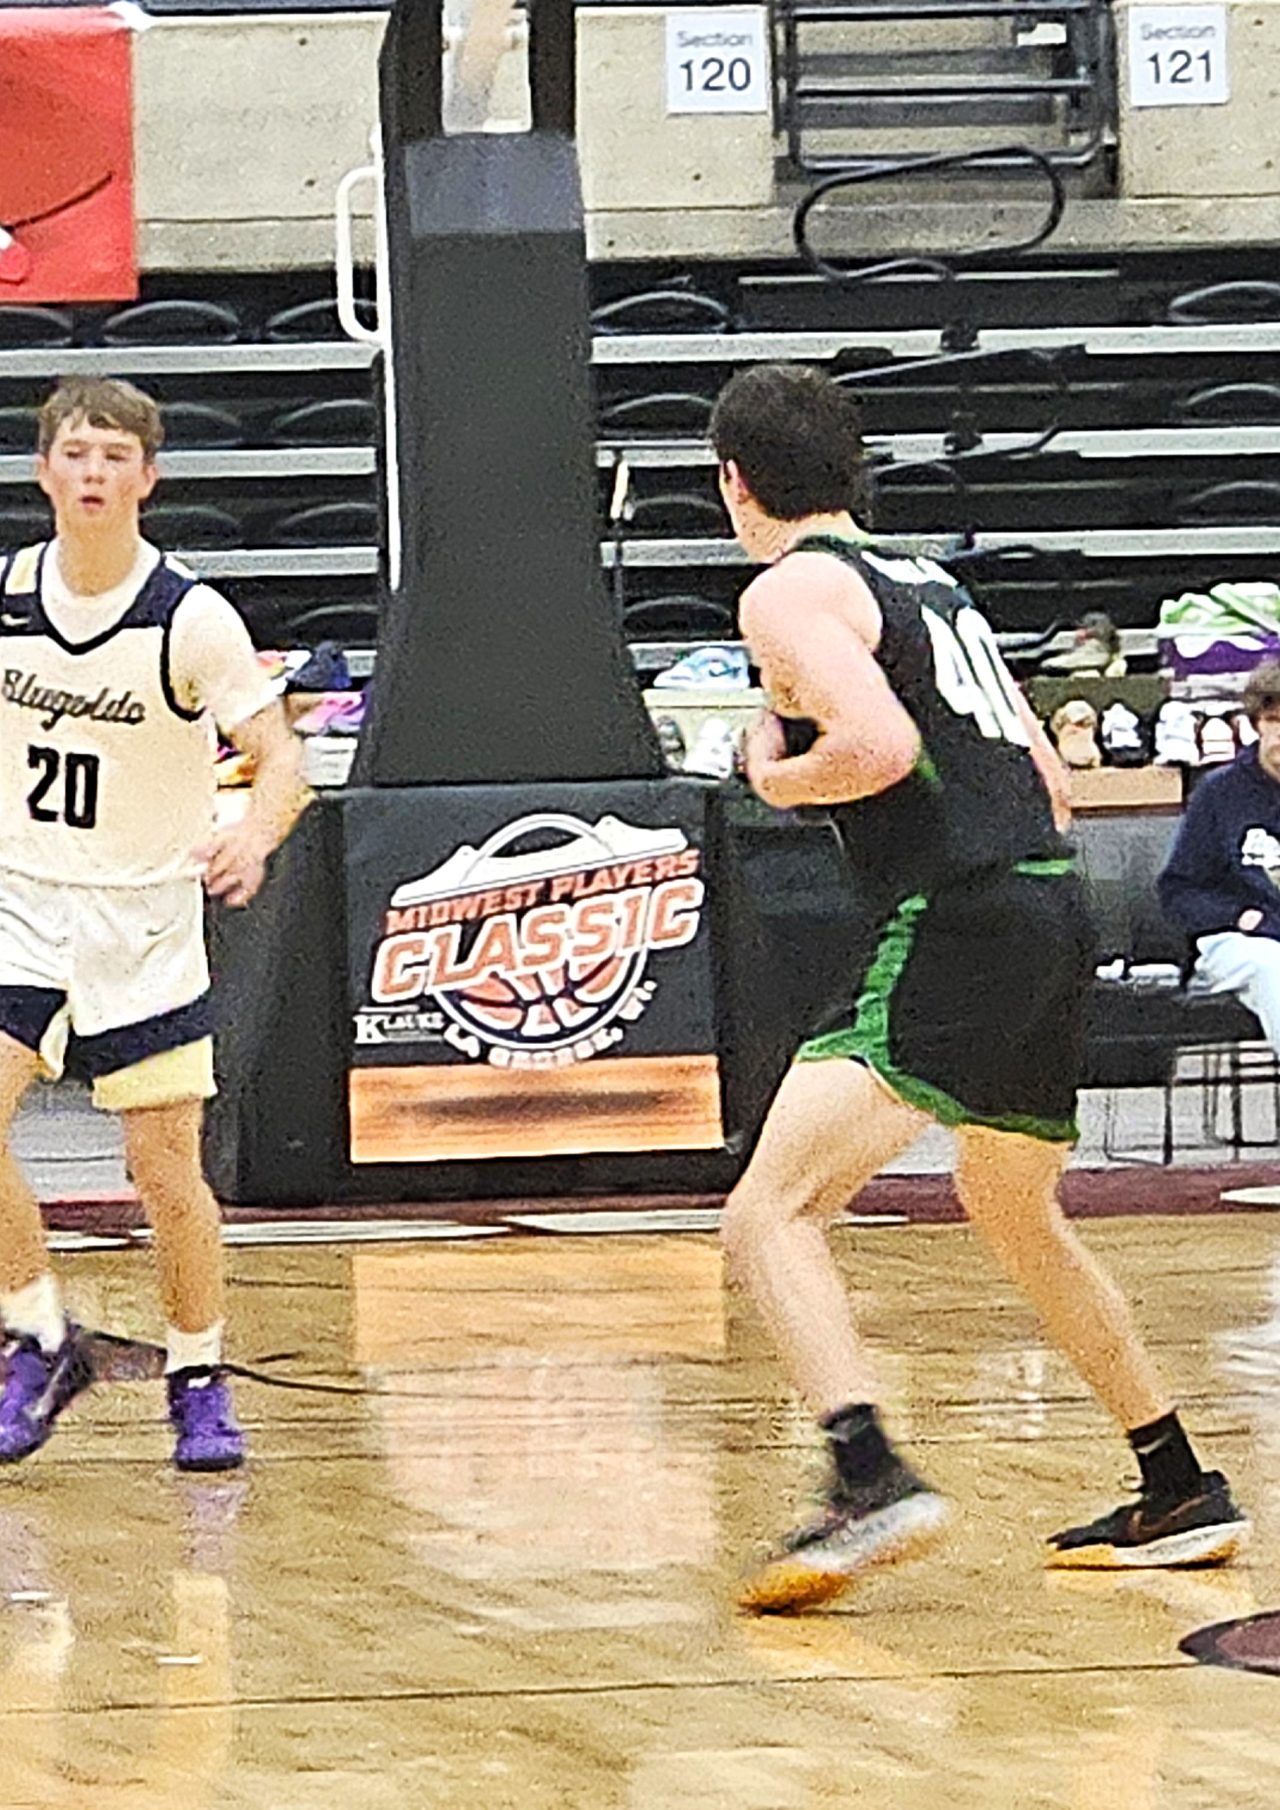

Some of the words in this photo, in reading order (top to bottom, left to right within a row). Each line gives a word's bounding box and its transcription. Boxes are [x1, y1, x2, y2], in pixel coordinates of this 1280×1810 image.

[677, 29, 754, 48] Section
[1141, 22, 1217, 41] Section
[679, 57, 752, 93] 120
[1147, 50, 1212, 84] 121
[27, 744, 100, 829] 20
[384, 881, 546, 935] MIDWEST
[549, 849, 700, 905] PLAYERS
[373, 879, 703, 1001] CLASSIC
